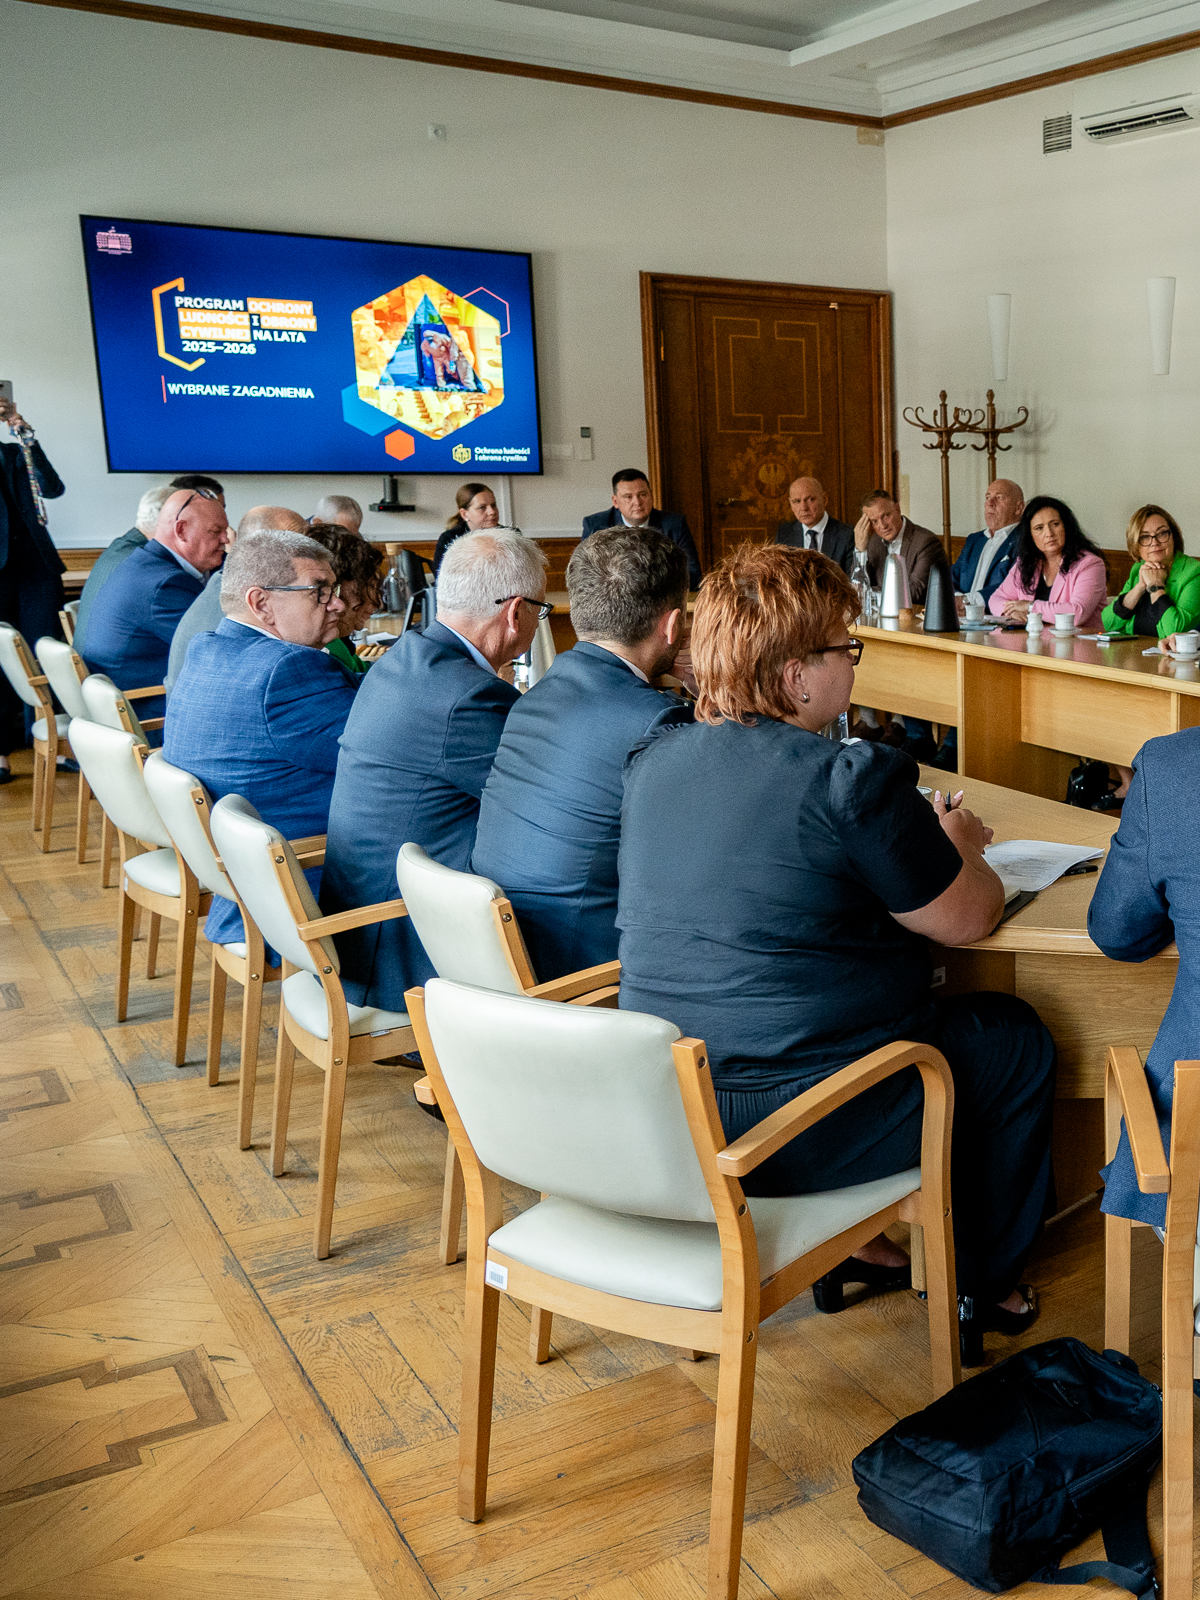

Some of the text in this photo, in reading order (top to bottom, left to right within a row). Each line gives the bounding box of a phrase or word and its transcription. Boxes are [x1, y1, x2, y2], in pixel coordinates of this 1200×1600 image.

[174, 296, 312, 315] PROGRAM OCHRONY
[179, 311, 316, 329] LUDNOŚCI I OBRONY
[180, 326, 306, 343] CYWILNEJ NA LATA
[167, 383, 315, 399] WYBRANE ZAGADNIENIA
[474, 446, 530, 455] Ochrona ludności
[502, 454, 528, 462] cywilna
